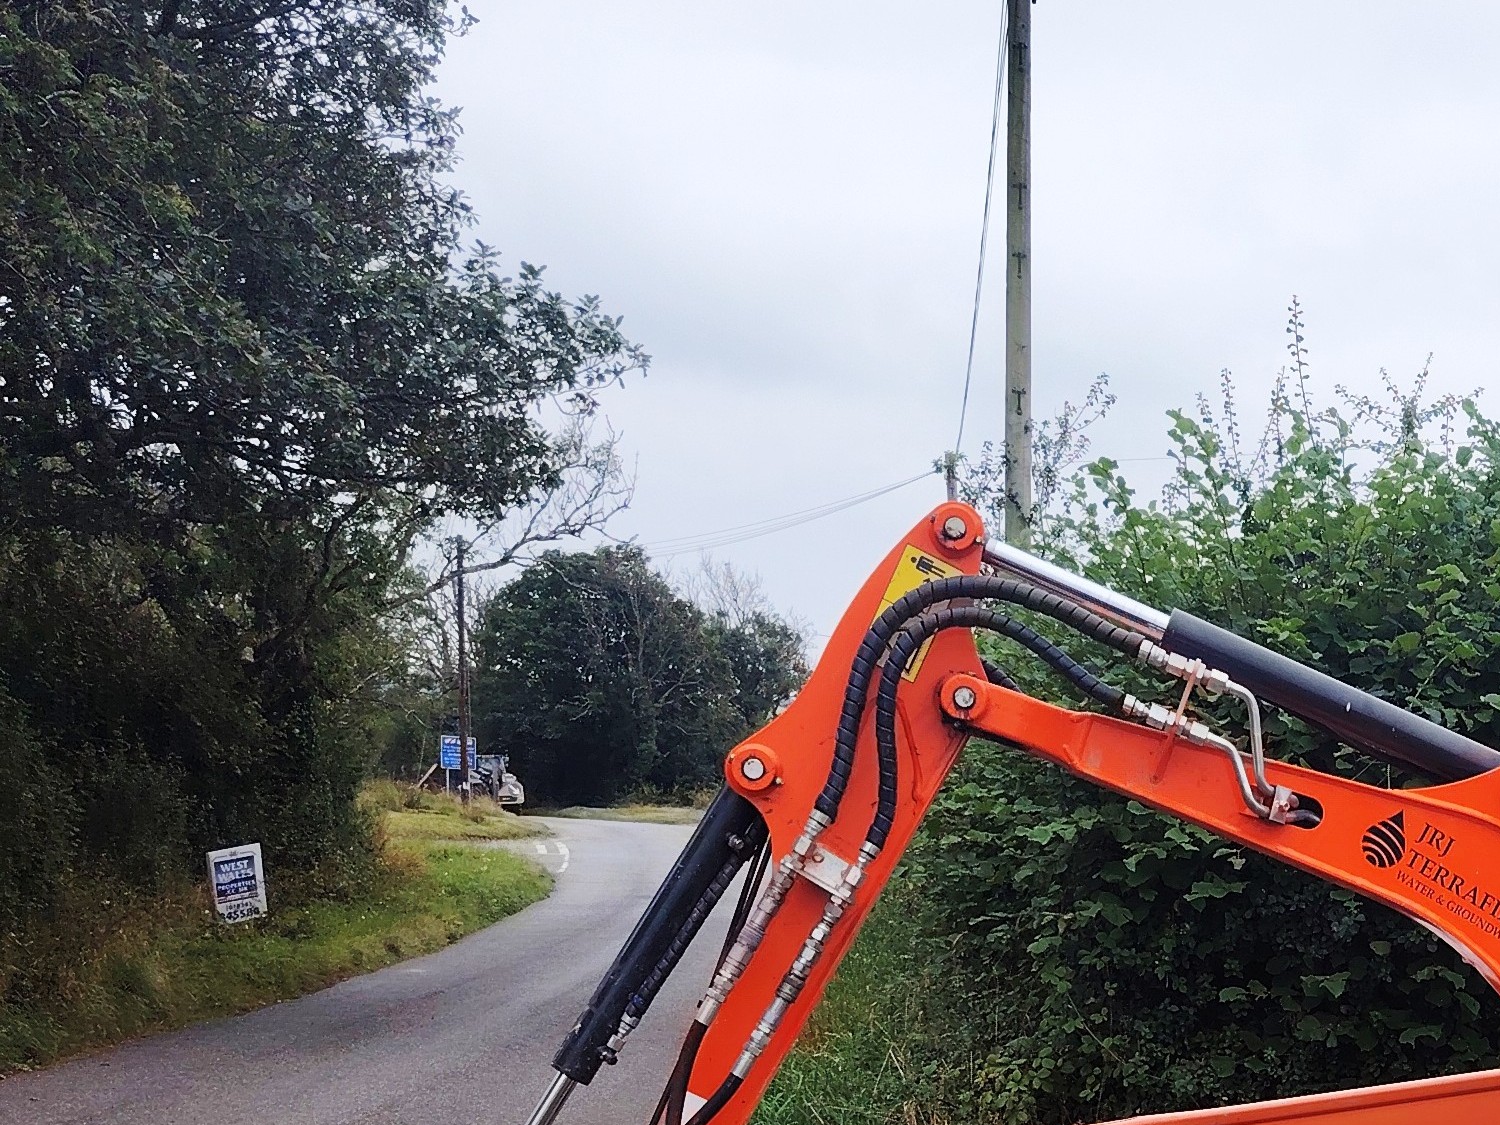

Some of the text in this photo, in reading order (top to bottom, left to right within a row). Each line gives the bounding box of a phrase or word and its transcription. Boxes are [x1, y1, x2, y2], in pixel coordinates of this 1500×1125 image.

[1415, 822, 1456, 857] JRJ
[217, 867, 254, 883] WALES
[220, 860, 248, 872] WEST
[1397, 870, 1435, 902] WATER
[1436, 895, 1444, 905] &
